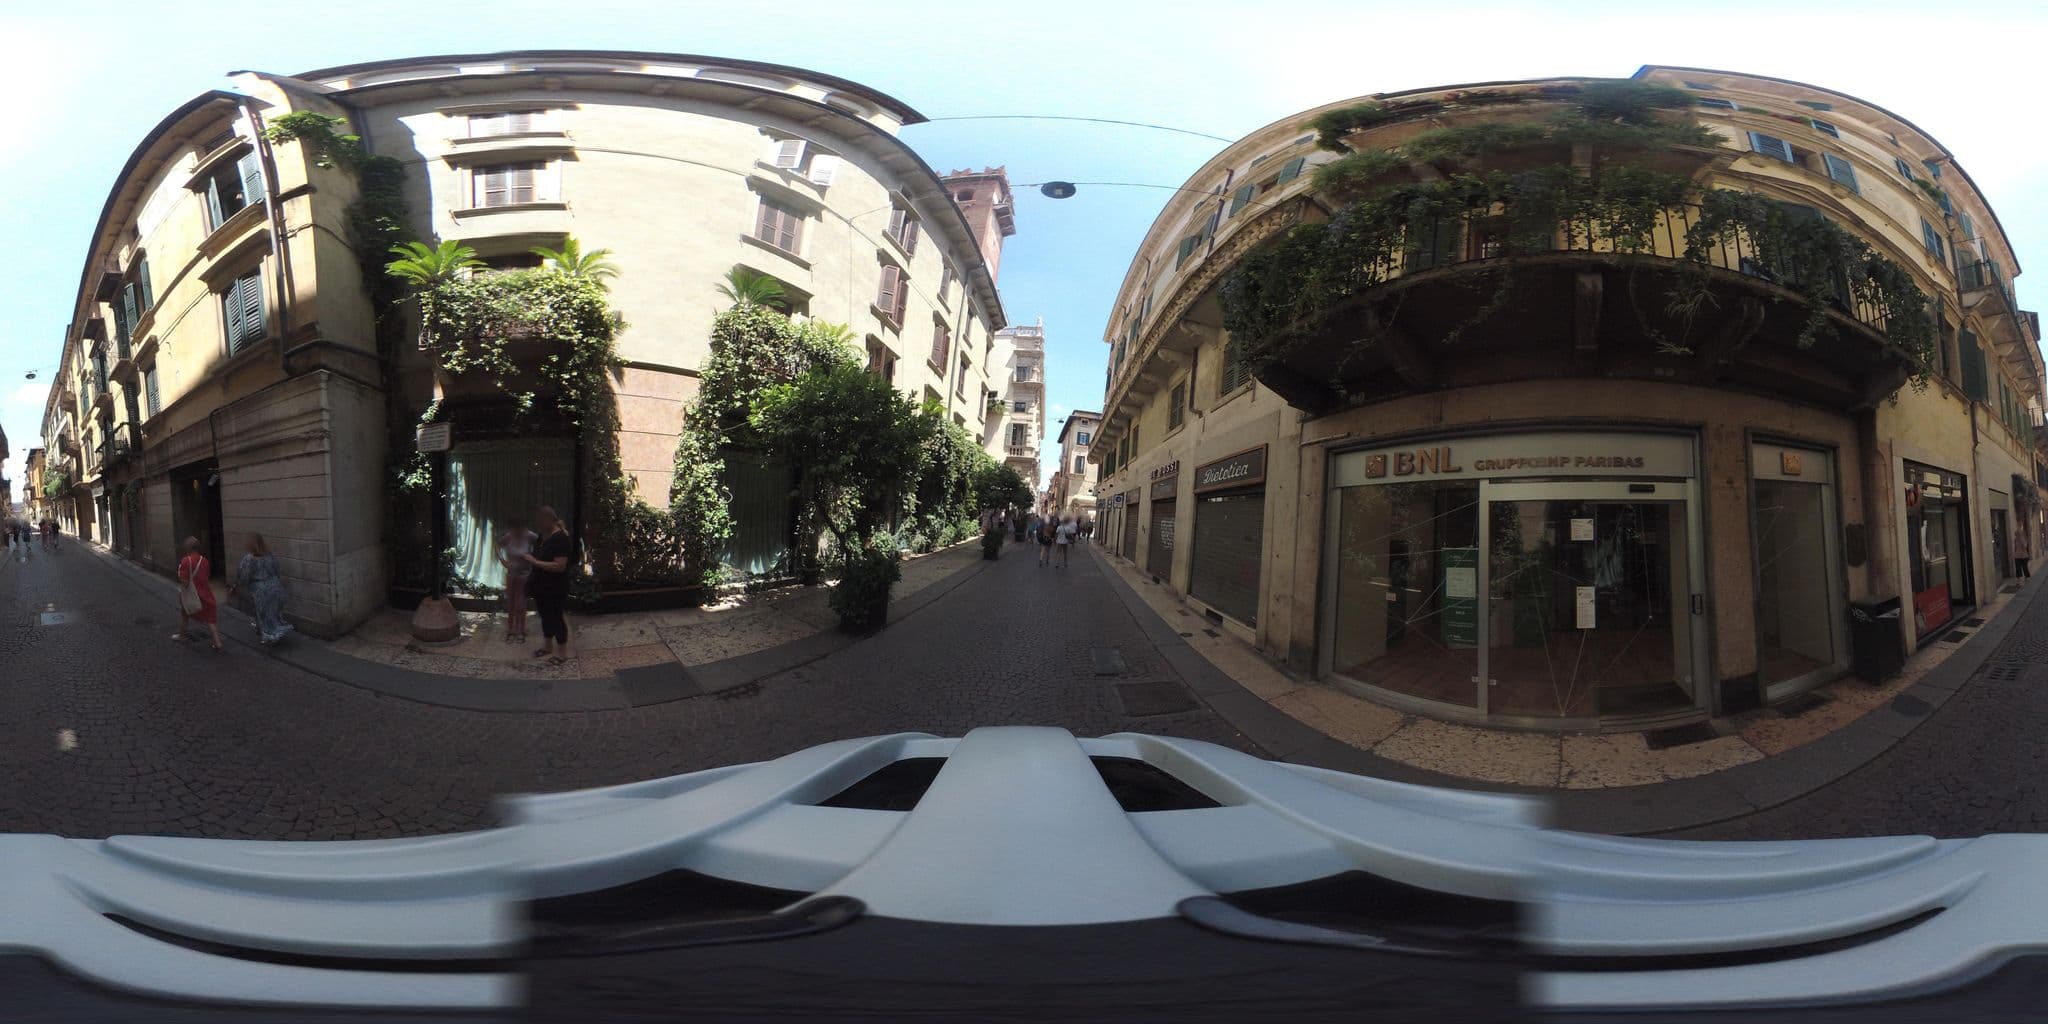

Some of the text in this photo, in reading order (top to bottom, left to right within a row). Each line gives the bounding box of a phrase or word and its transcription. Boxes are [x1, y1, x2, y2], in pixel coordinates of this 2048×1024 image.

[1202, 461, 1249, 484] Dietetica
[1393, 446, 1462, 476] BNL
[1575, 456, 1645, 468] PARIBAS
